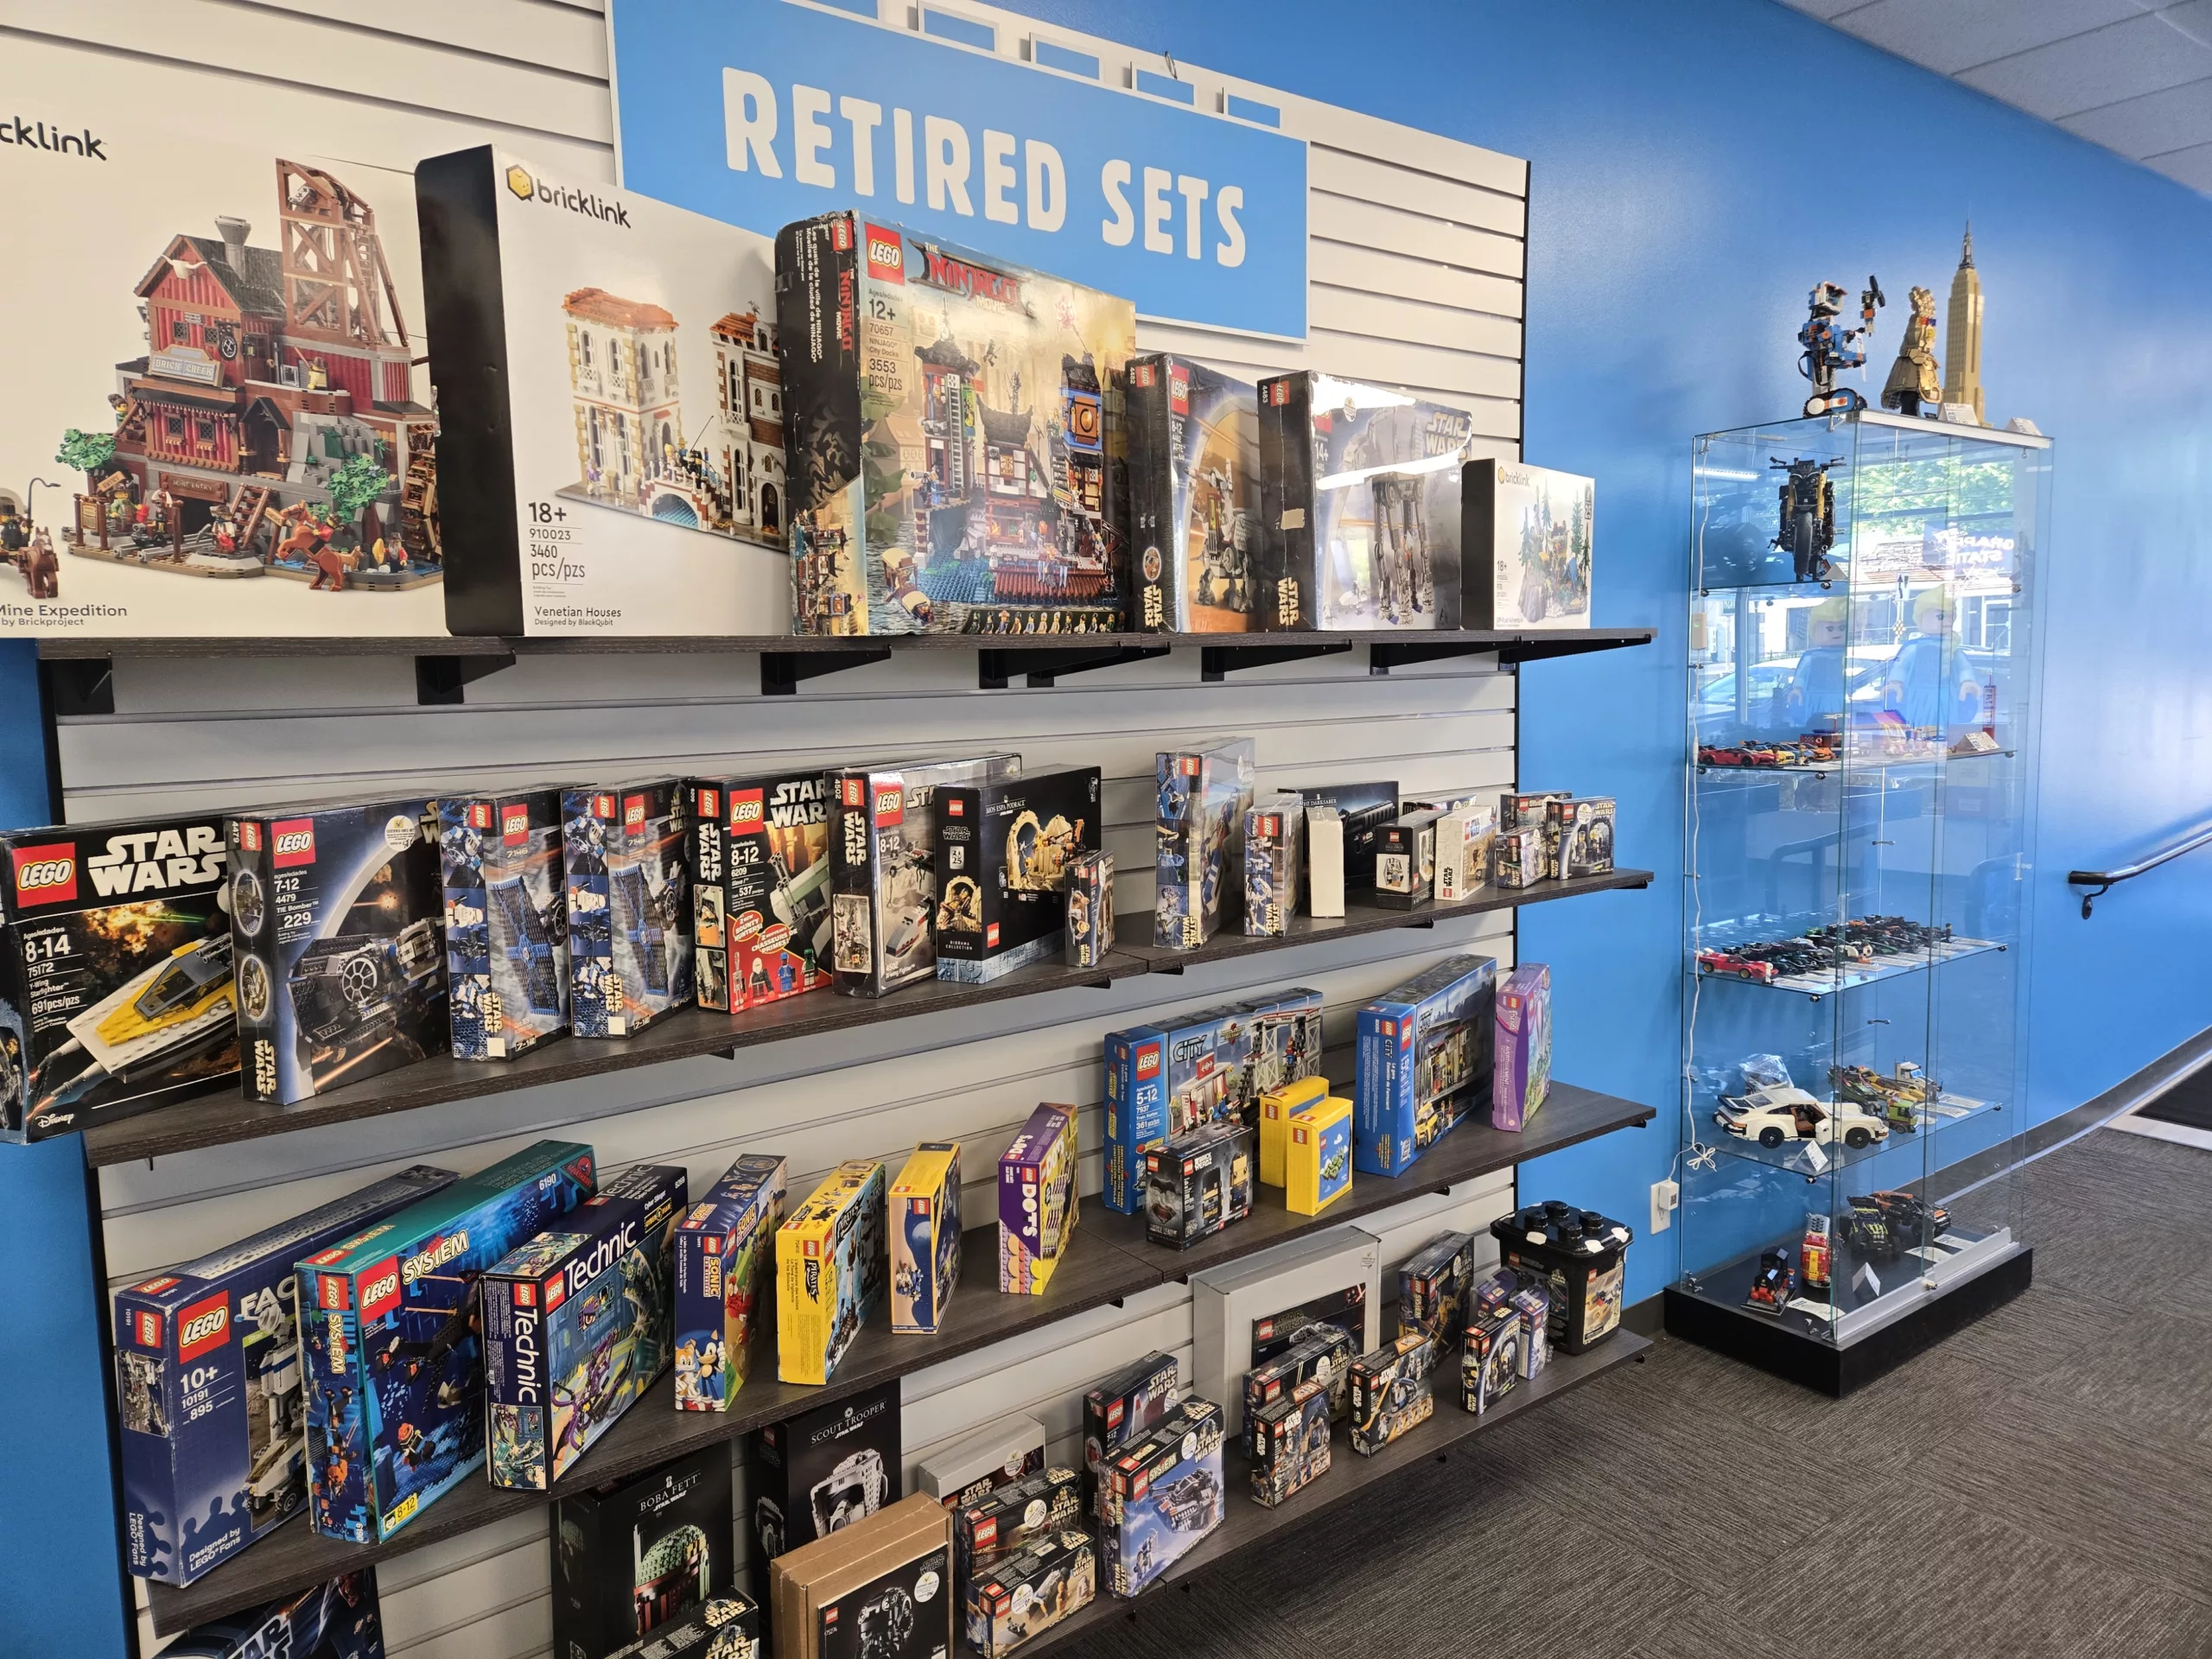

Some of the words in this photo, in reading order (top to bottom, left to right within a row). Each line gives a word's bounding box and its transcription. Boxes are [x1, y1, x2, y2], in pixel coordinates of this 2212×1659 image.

[722, 67, 1067, 232] RETIRED
[1102, 159, 1246, 267] SETS
[537, 178, 631, 229] bricklink
[869, 241, 901, 268] LEGO
[925, 242, 939, 254] THE
[868, 298, 896, 321] 12+
[869, 322, 894, 337] 70657
[869, 347, 880, 358] City
[881, 348, 899, 358] Docks
[155, 359, 181, 371] BRICK
[186, 364, 213, 377] CREEK
[869, 359, 896, 373] 3553
[868, 374, 903, 393] pcs/pzs
[1172, 378, 1188, 401] LEGO
[1275, 383, 1285, 404] LEGO
[1426, 411, 1467, 437] STAR
[1315, 442, 1329, 461] 14+
[528, 502, 567, 524] 18+
[530, 528, 571, 541] 910023
[531, 544, 558, 559] 3460
[532, 557, 586, 582] pcs/pzs
[1143, 585, 1154, 627] WARS
[1153, 585, 1164, 627] STAR
[1277, 577, 1289, 626] WARS
[1287, 576, 1300, 626] STAR
[39, 604, 127, 619] Expedition
[534, 607, 582, 617] Venetian
[586, 607, 622, 617] Houses
[2, 618, 15, 627] by
[19, 618, 84, 627] Brickproject
[535, 619, 566, 627] Designed
[579, 619, 613, 627] BlackQubit
[876, 792, 900, 813] LEGO
[986, 805, 995, 815] MOS
[996, 804, 1006, 812] ESPA
[1311, 798, 1338, 806] DARKSABER
[626, 805, 645, 824] LEGO
[733, 802, 762, 823] LEGO
[770, 803, 827, 829] WAR
[1594, 808, 1614, 817] WARS
[505, 817, 527, 836] LEGO
[943, 826, 970, 836] STAR
[276, 832, 312, 854] LEGO
[627, 836, 646, 847] 7146
[843, 811, 856, 866] WARS
[855, 811, 867, 866] STAR
[880, 836, 900, 853] 8-12
[944, 832, 971, 841] WARS
[87, 826, 226, 868] STAR
[698, 823, 712, 881] WARS
[709, 823, 722, 881] STAR
[731, 847, 760, 866] 8-12
[19, 861, 71, 889] LEGO
[88, 852, 226, 898] WARS
[731, 868, 747, 878] 6209
[274, 878, 300, 893] 7-12
[739, 886, 753, 896] 537
[275, 893, 296, 904] 4479
[276, 906, 287, 914] TIE
[283, 912, 312, 928] 229
[735, 918, 760, 934] BOUNTY
[734, 924, 763, 942] HUNTERS!
[752, 933, 788, 951] CHASSEURS
[1190, 916, 1199, 949] STAR
[25, 934, 71, 963] 8-14
[27, 962, 54, 978] 75172
[29, 979, 49, 990] Y-Wing
[1173, 1034, 1208, 1063] CITY
[254, 1039, 268, 1095] WARS
[264, 1039, 277, 1096] STAR
[1137, 1052, 1160, 1071] LEGO
[1136, 1089, 1158, 1105] 5-12
[1009, 1135, 1033, 1154] DOTS
[538, 1173, 556, 1191] 6190
[595, 1165, 654, 1198] Technic
[1022, 1184, 1037, 1236] DOTS
[315, 1250, 344, 1265] LEGO
[403, 1230, 470, 1286] SYSTEM
[564, 1220, 637, 1295] Technic
[143, 1278, 172, 1293] LEGO
[709, 1257, 721, 1297] SONIC
[808, 1262, 818, 1296] PIRATES
[326, 1277, 340, 1309] LEGO
[361, 1274, 397, 1310] LEGO
[546, 1281, 563, 1303] LEGO
[182, 1308, 226, 1344] LEGO
[1274, 1311, 1304, 1326] STAR
[1274, 1319, 1305, 1336] WARS
[144, 1313, 155, 1344] LEGO
[327, 1312, 347, 1375] SYSTEM
[514, 1308, 542, 1404] Technic
[1331, 1354, 1349, 1368] STAR
[180, 1366, 218, 1394] 10+
[1147, 1364, 1176, 1390] STAR
[181, 1389, 208, 1408] 10191
[1147, 1376, 1177, 1402] WARS
[1266, 1388, 1281, 1401] LEGO
[190, 1401, 213, 1421] 895
[1109, 1408, 1122, 1424] LEGO
[811, 1423, 842, 1444] SCOUT
[1107, 1431, 1117, 1441] 7-12
[1195, 1430, 1220, 1453] STAR
[1194, 1438, 1221, 1464] WARS
[1149, 1453, 1177, 1483] SYSTEM
[961, 1478, 992, 1497] STAR
[1135, 1477, 1147, 1494] LEGO
[397, 1497, 416, 1518] 8-12
[640, 1491, 669, 1511] BOBA
[1051, 1497, 1079, 1514] STAR
[1051, 1504, 1079, 1522] WARS
[137, 1513, 147, 1554] Designed
[355, 1522, 364, 1541] 6190
[976, 1527, 996, 1541] LEGO
[189, 1533, 228, 1562] Designed
[229, 1528, 240, 1537] by
[219, 1536, 241, 1554] Fans
[140, 1555, 147, 1567] by
[922, 1554, 945, 1569] STAR
[704, 1601, 745, 1624] STAR
[708, 1605, 747, 1628] WARS
